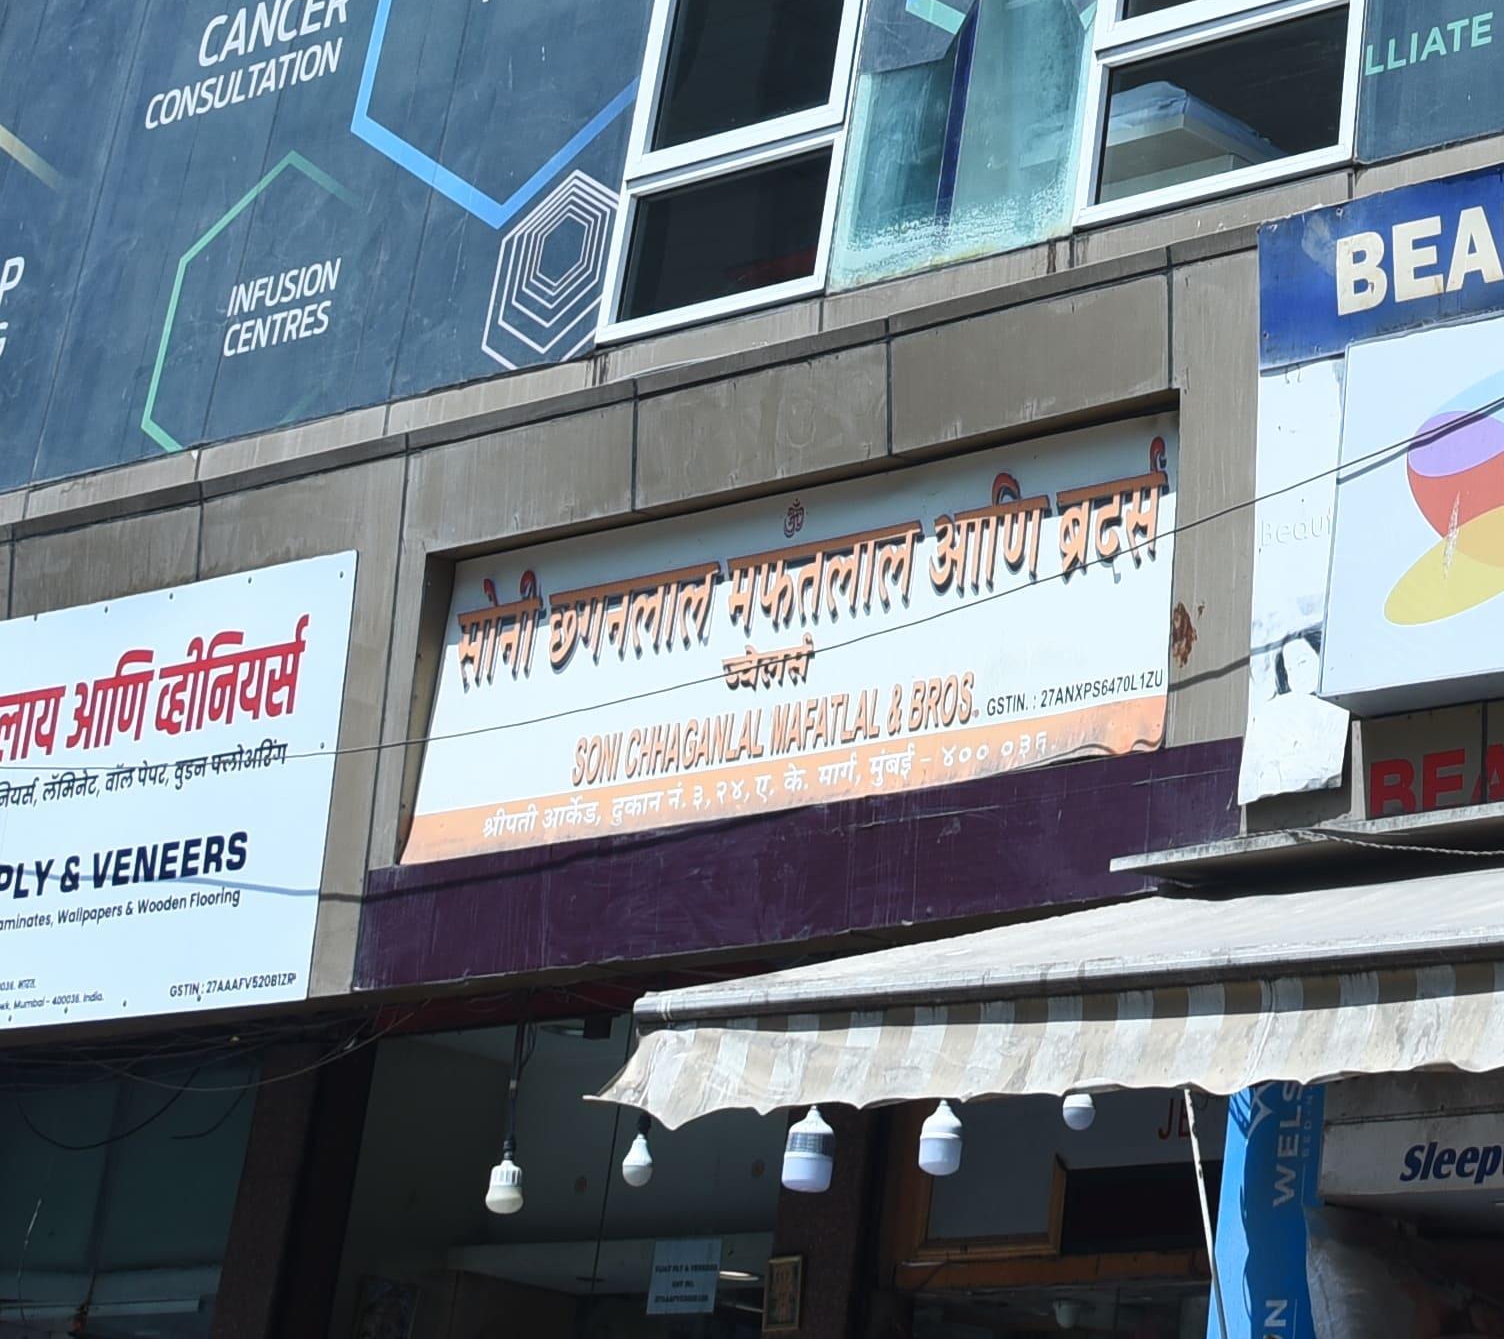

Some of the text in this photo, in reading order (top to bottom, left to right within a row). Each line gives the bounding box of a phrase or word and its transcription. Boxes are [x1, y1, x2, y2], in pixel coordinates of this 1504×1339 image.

[1365, 10, 1494, 78] LLIATE
[144, 37, 343, 129] CONSULTATION
[227, 257, 341, 318] INFUSION
[222, 301, 332, 359] CENTRES
[457, 569, 543, 692] सोनी
[549, 561, 723, 673] छगनलाल
[727, 520, 924, 636] मफतलाल
[930, 473, 1051, 597] आणि
[66, 650, 155, 749] आणि
[572, 731, 623, 786] SONI
[625, 707, 764, 777] CHHAGANLAL
[770, 690, 881, 756] MAFATLAL
[887, 682, 903, 735] &
[483, 805, 538, 838] श्रीपती
[59, 855, 80, 893] &
[92, 831, 248, 889] VENEERS
[57, 901, 123, 925] Wallpapers
[125, 901, 134, 916] &
[137, 896, 187, 914] Wooden
[189, 887, 241, 908] Flooring
